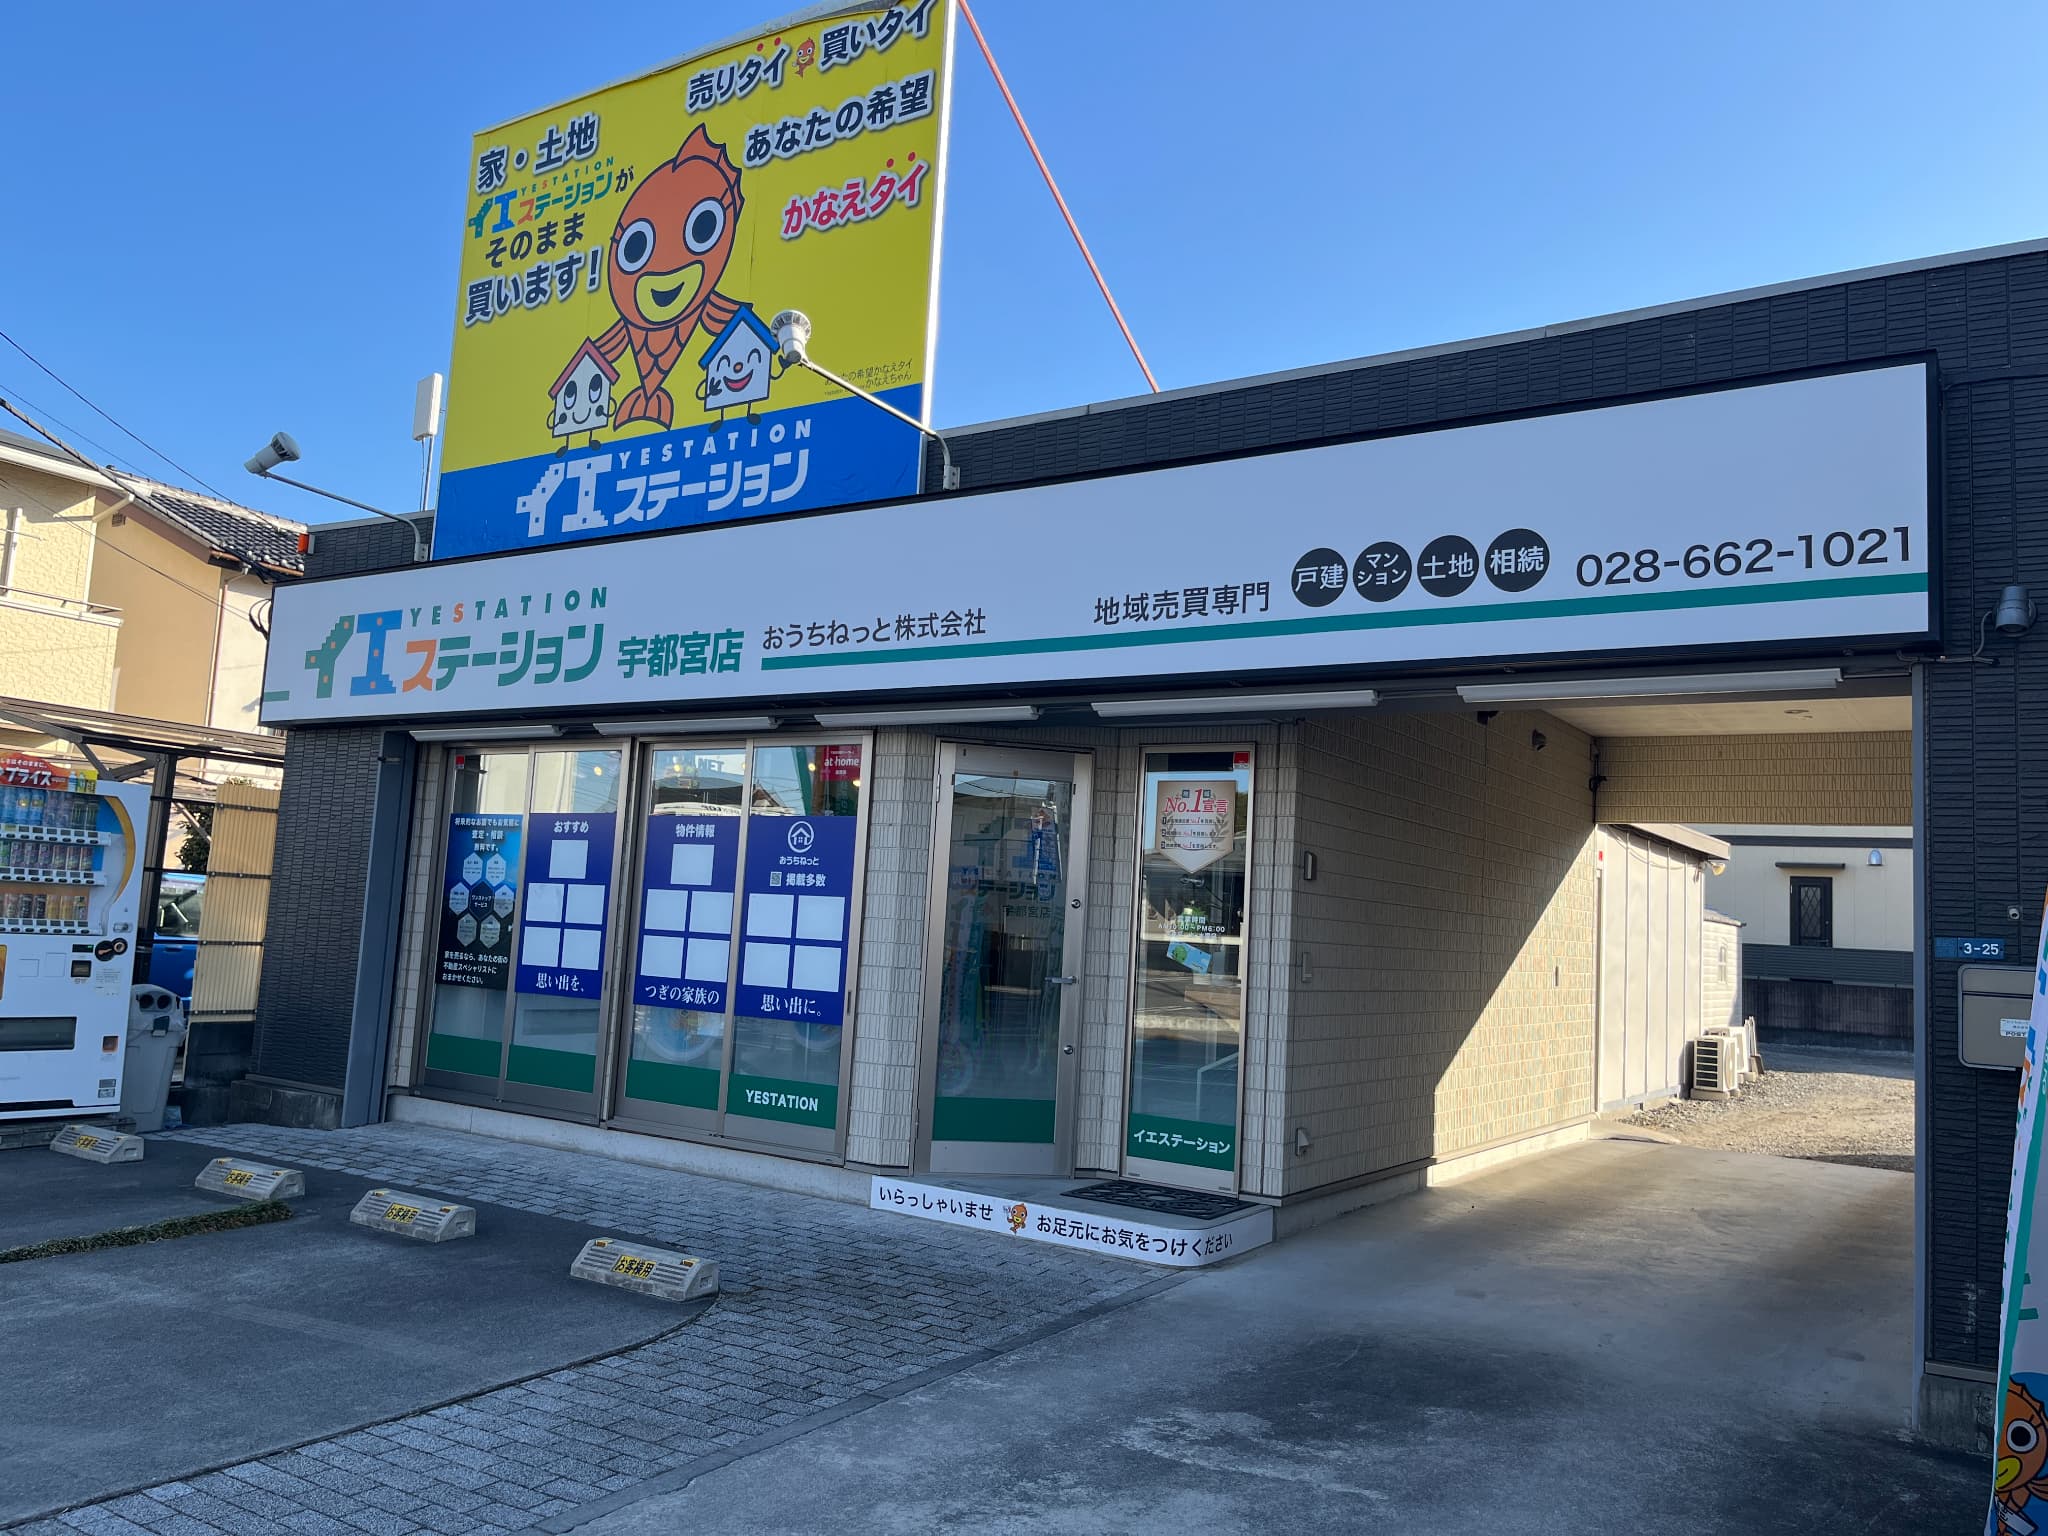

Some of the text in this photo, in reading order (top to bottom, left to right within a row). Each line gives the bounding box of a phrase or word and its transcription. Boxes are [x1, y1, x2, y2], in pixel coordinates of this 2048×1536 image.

[820, 0, 937, 67] 買いタイ
[687, 46, 788, 110] 売りタイ
[745, 74, 931, 162] あなたの希望
[477, 115, 597, 190] 家・土地
[520, 156, 614, 196] YESTATION
[782, 163, 925, 235] かなえタイ
[485, 211, 585, 269] そのまま
[618, 418, 812, 470] YESTATION
[515, 448, 810, 538] イエステーション
[1365, 551, 1400, 569] マン
[1420, 551, 1475, 582] 土地
[1489, 545, 1546, 576] 相続
[1575, 526, 1911, 588] 028-662-1021
[1294, 564, 1346, 594] 戸建
[1356, 567, 1408, 588] ション
[410, 586, 608, 628] YESTATION
[1093, 580, 1271, 626] 地域売買専門
[762, 607, 987, 651] おうちねっと株式会社
[617, 627, 745, 679] 宇都宮店
[834, 755, 860, 767] home
[553, 820, 590, 834] おすすめ
[675, 823, 716, 839] 物件情報
[779, 855, 820, 866] おうちねっと
[785, 872, 827, 888] 掲載多数
[1963, 942, 2000, 956] 3-25
[644, 983, 721, 1007] つぎの家族の
[760, 993, 823, 1018] 思い出に。
[745, 1088, 820, 1112] YESTATION
[1133, 1128, 1232, 1155] イエステーション
[878, 1186, 994, 1222] いらっしゃいませ
[1036, 1214, 1233, 1258] お足元にお気をつけください
